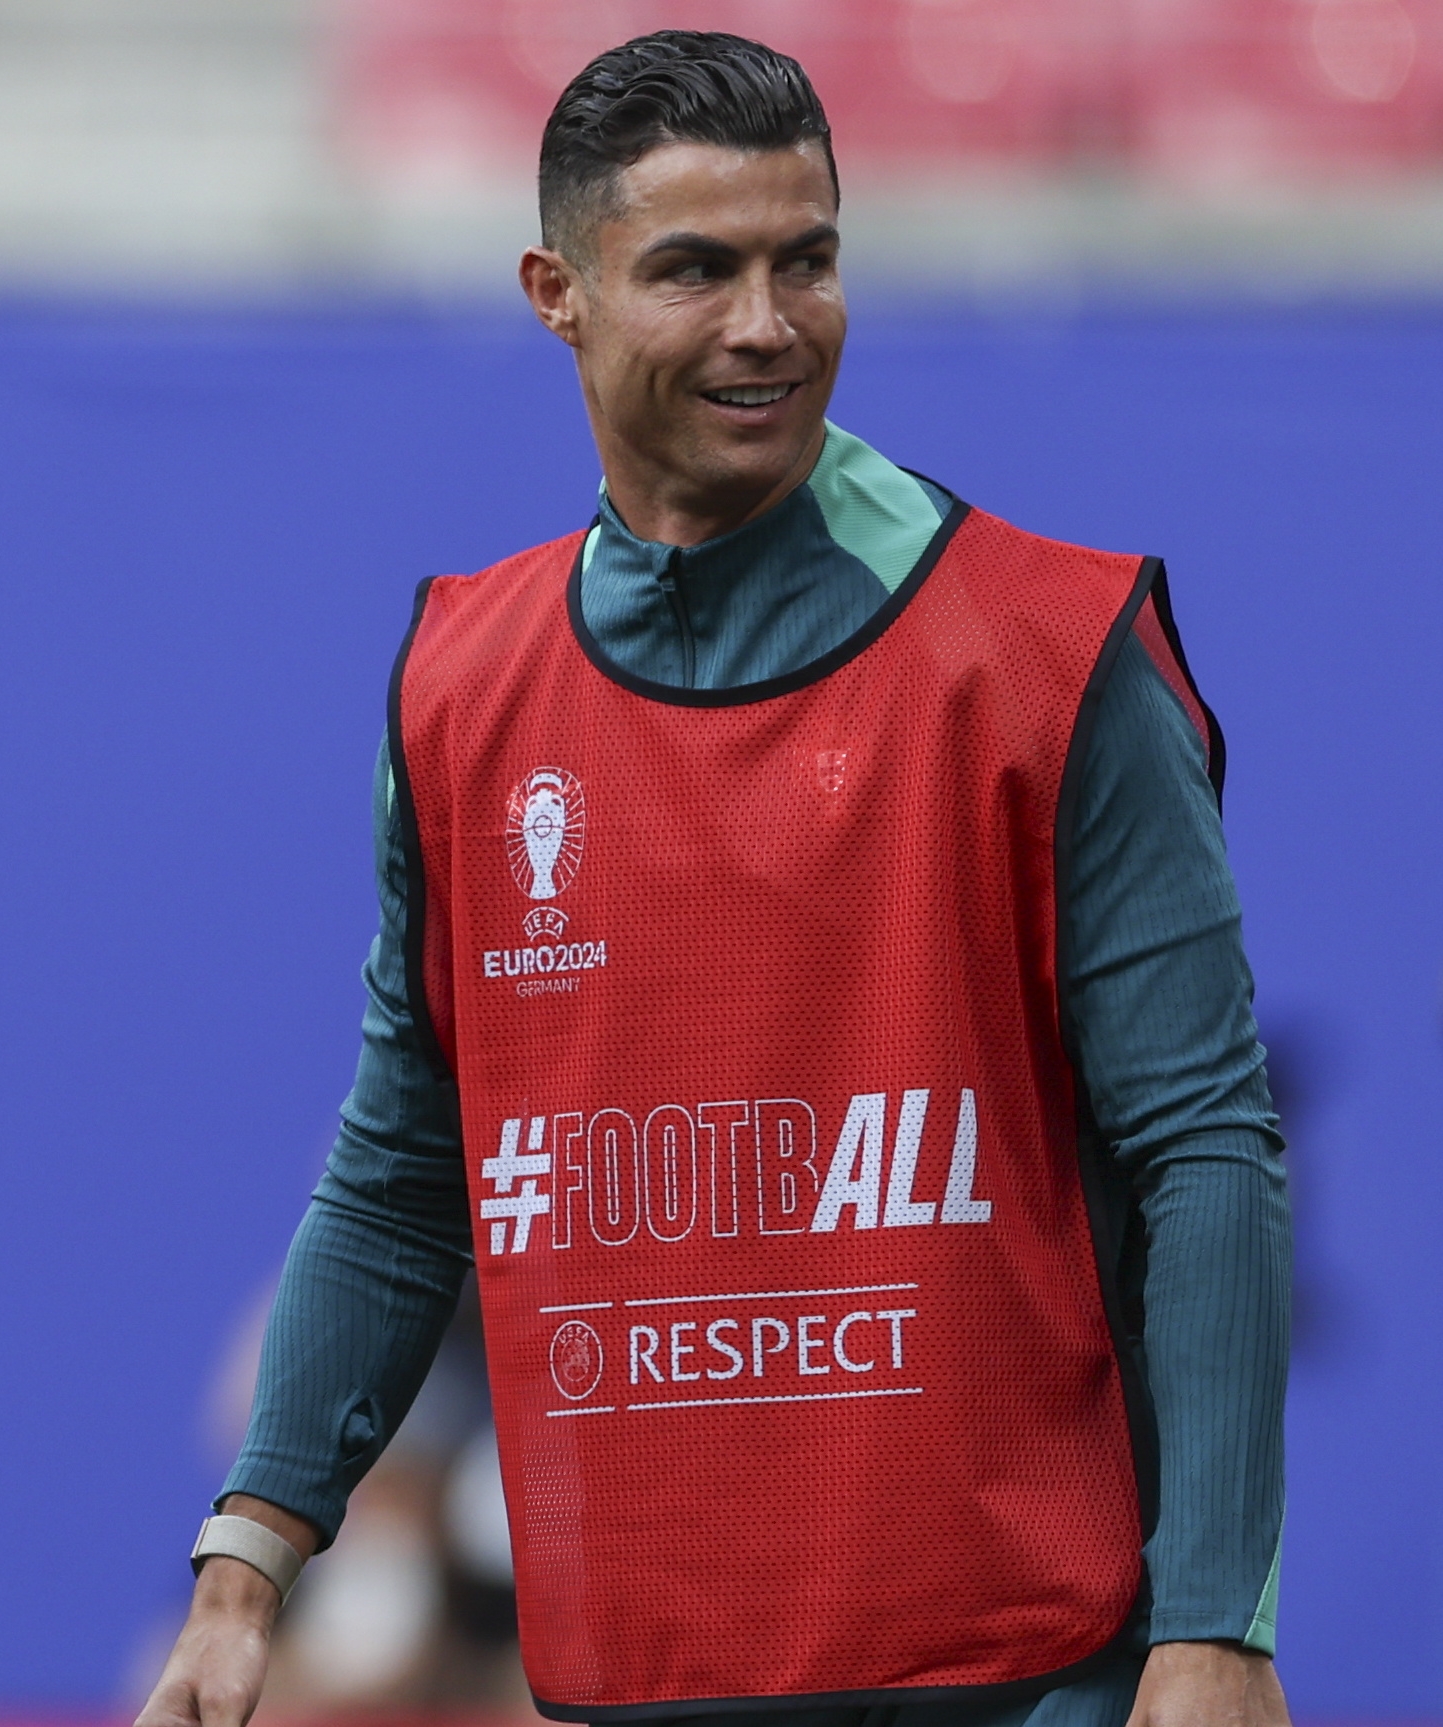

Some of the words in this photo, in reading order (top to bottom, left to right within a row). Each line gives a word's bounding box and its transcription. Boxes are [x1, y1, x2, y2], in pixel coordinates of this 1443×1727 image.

[523, 912, 565, 937] UEFA
[483, 940, 608, 978] EURO2024
[516, 977, 580, 998] GERMANY
[480, 1088, 992, 1256] #FOOTBALL
[558, 1326, 590, 1344] UEFA
[629, 1309, 917, 1385] RESPECT
